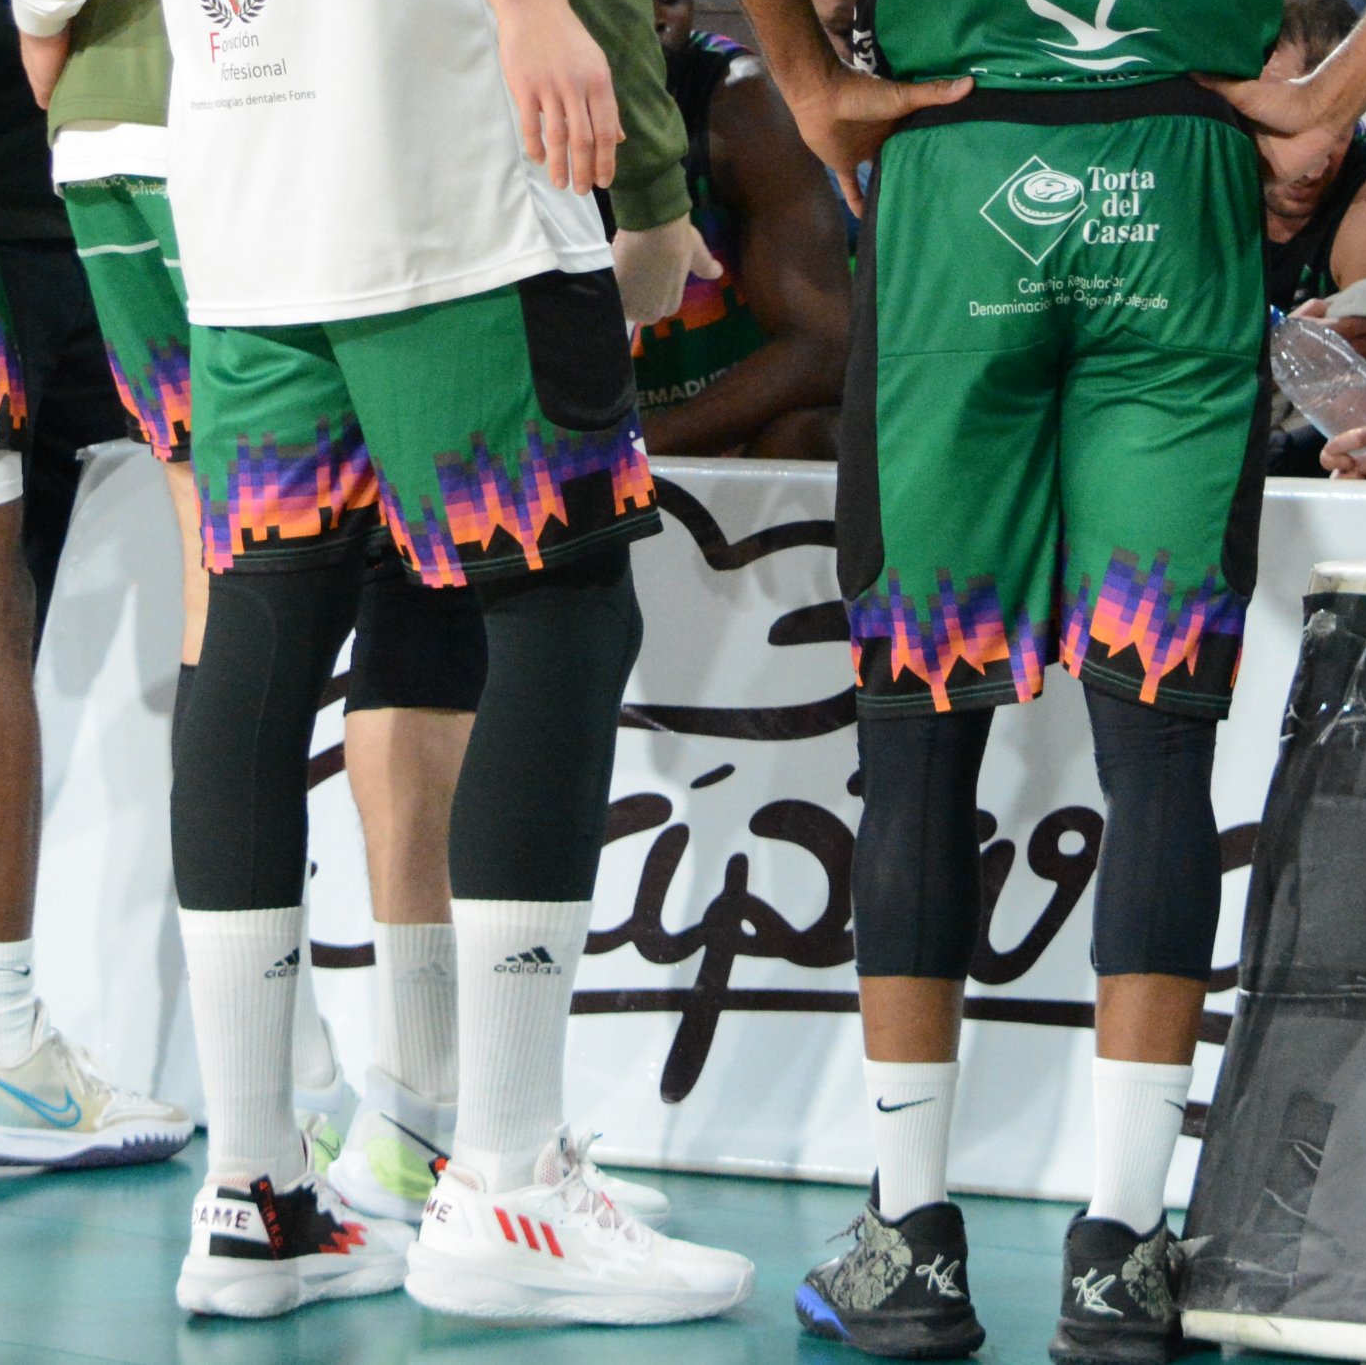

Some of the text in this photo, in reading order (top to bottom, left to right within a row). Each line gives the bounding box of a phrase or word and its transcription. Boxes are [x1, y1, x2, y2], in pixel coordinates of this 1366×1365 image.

[1087, 166, 1156, 192] Torta
[1101, 192, 1141, 218] del
[1082, 218, 1160, 246] Casar
[493, 962, 562, 975] adidas
